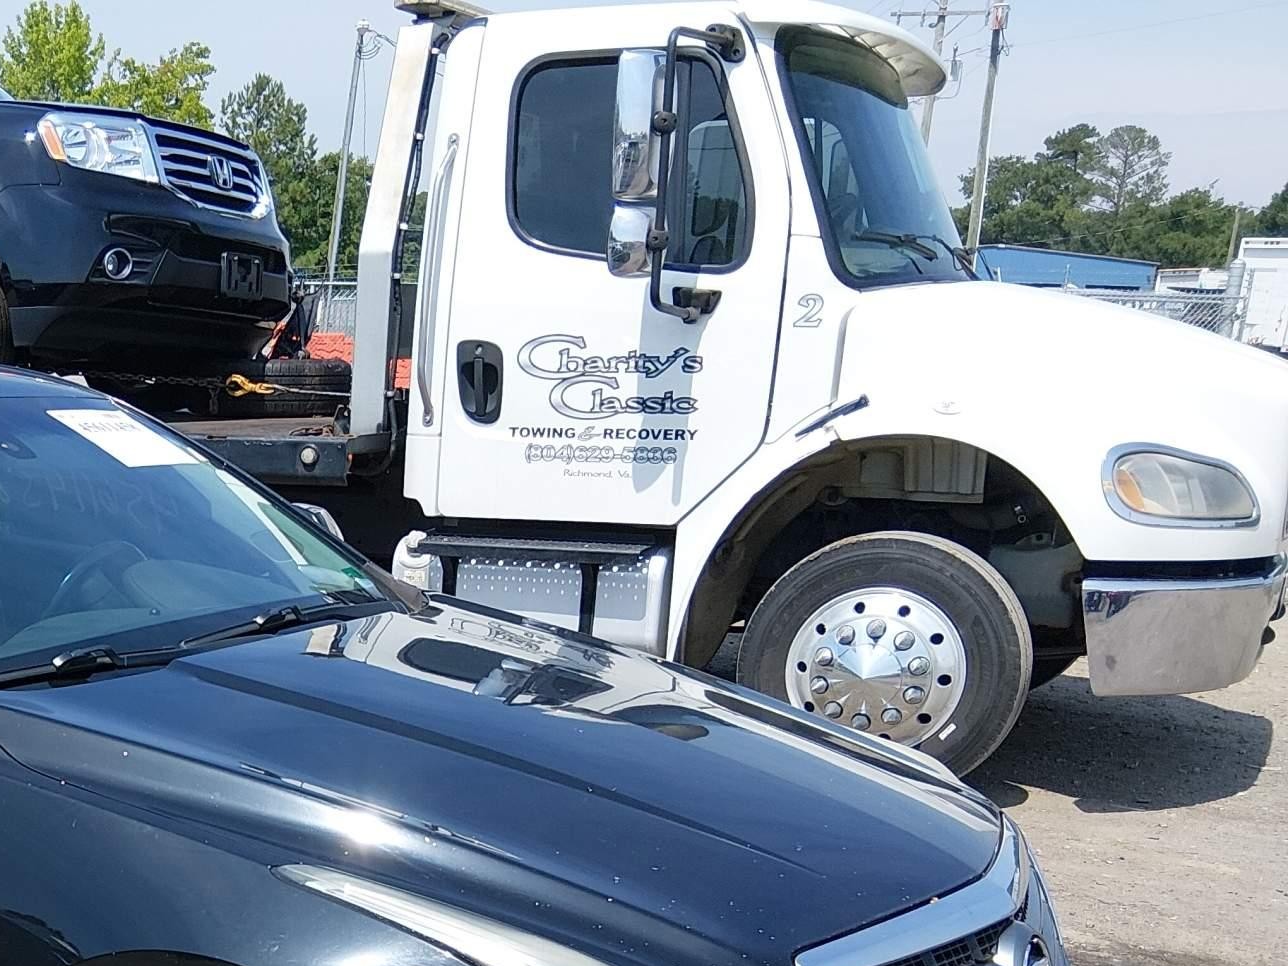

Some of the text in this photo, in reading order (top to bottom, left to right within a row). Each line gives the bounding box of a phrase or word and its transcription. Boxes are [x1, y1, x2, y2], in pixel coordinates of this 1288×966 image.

[793, 293, 824, 328] 2
[517, 333, 703, 380] Charity's
[549, 374, 699, 421] Classic
[509, 425, 699, 442] TOWING & RECOVERY
[525, 443, 678, 466] (804)629-5836
